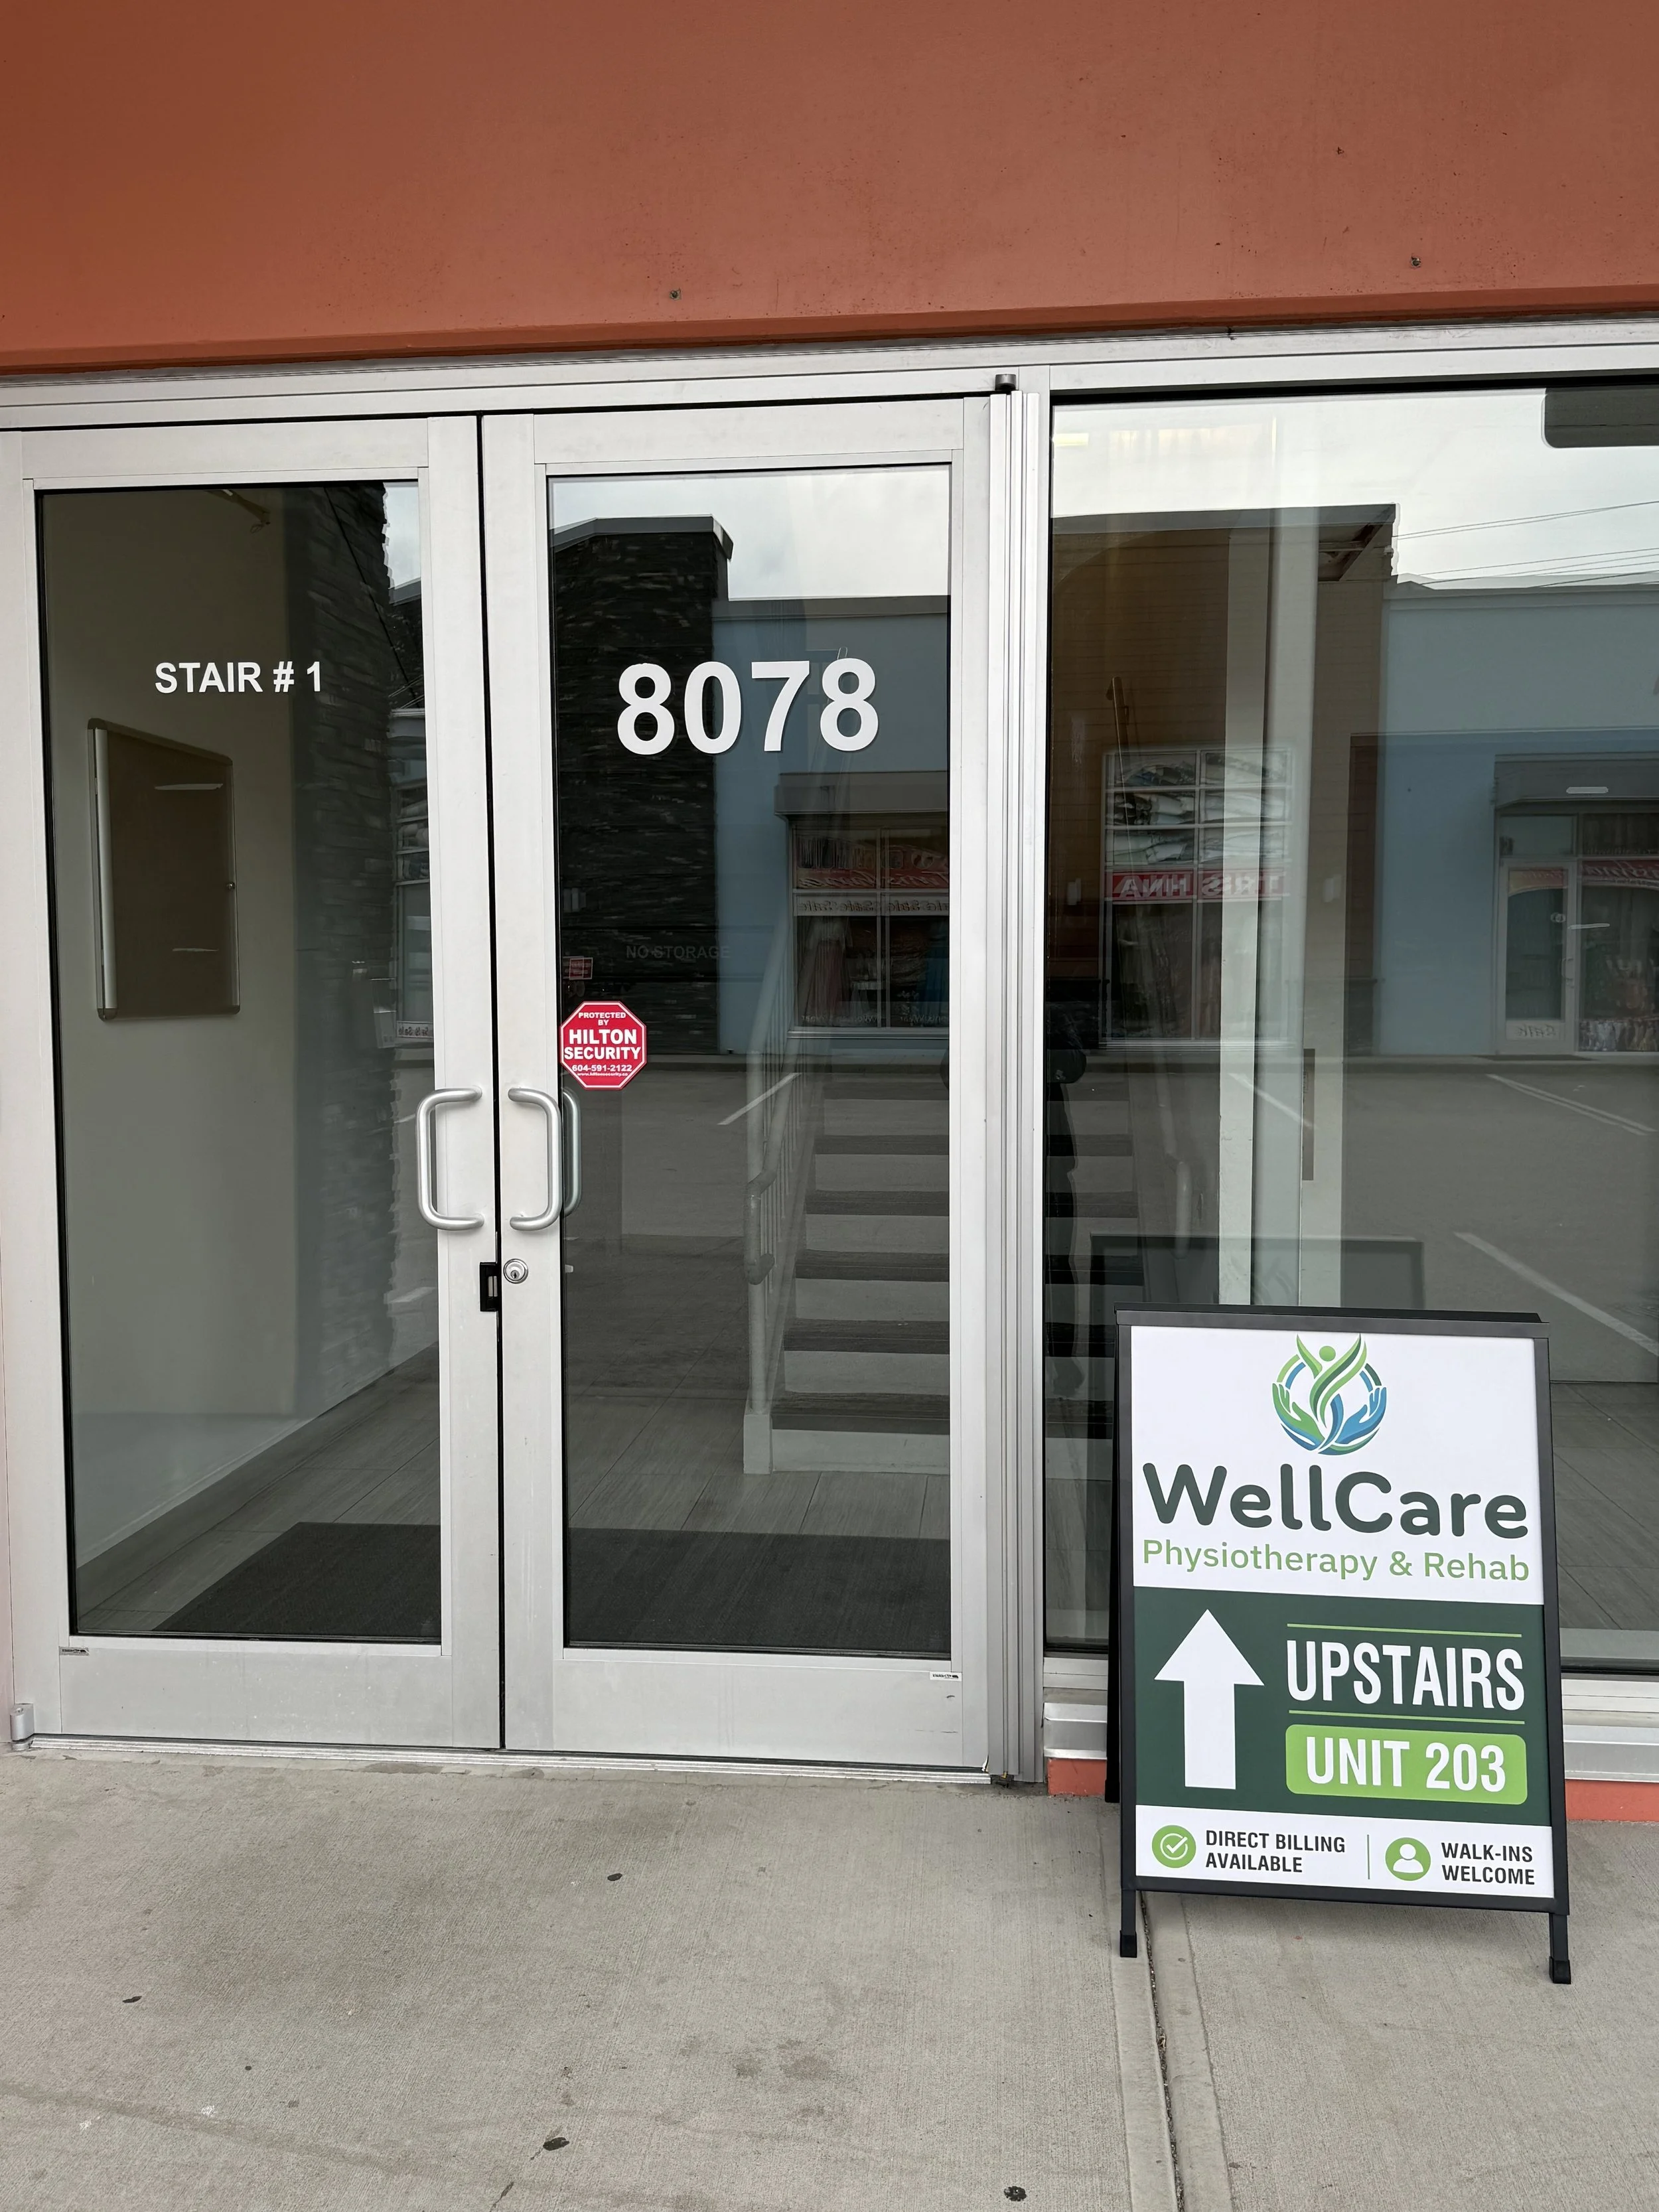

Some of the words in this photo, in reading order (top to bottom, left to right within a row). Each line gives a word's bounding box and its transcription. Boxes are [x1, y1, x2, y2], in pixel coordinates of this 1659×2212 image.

[155, 662, 263, 694] STAIR
[273, 662, 295, 693] #
[307, 662, 321, 692] 1
[617, 657, 879, 755] 8078
[626, 944, 648, 958] NO
[654, 944, 732, 959] STORAGE
[569, 1029, 637, 1045] HILTON
[564, 1047, 642, 1060] SECURITY
[1143, 1463, 1528, 1539] WellCare
[1144, 1538, 1378, 1581] Physiotherapy
[1390, 1551, 1413, 1576] &
[1425, 1551, 1529, 1581] Rehab
[1287, 1640, 1524, 1711] UPSTAIRS
[1307, 1736, 1410, 1787] UNIT
[1425, 1742, 1506, 1793] 203
[1206, 1830, 1269, 1848] DIRECT
[1275, 1834, 1345, 1853] BILLING
[1441, 1842, 1533, 1862] WALK-INS
[1205, 1852, 1303, 1873] AVAILABLE
[1441, 1865, 1535, 1885] WELCOME
